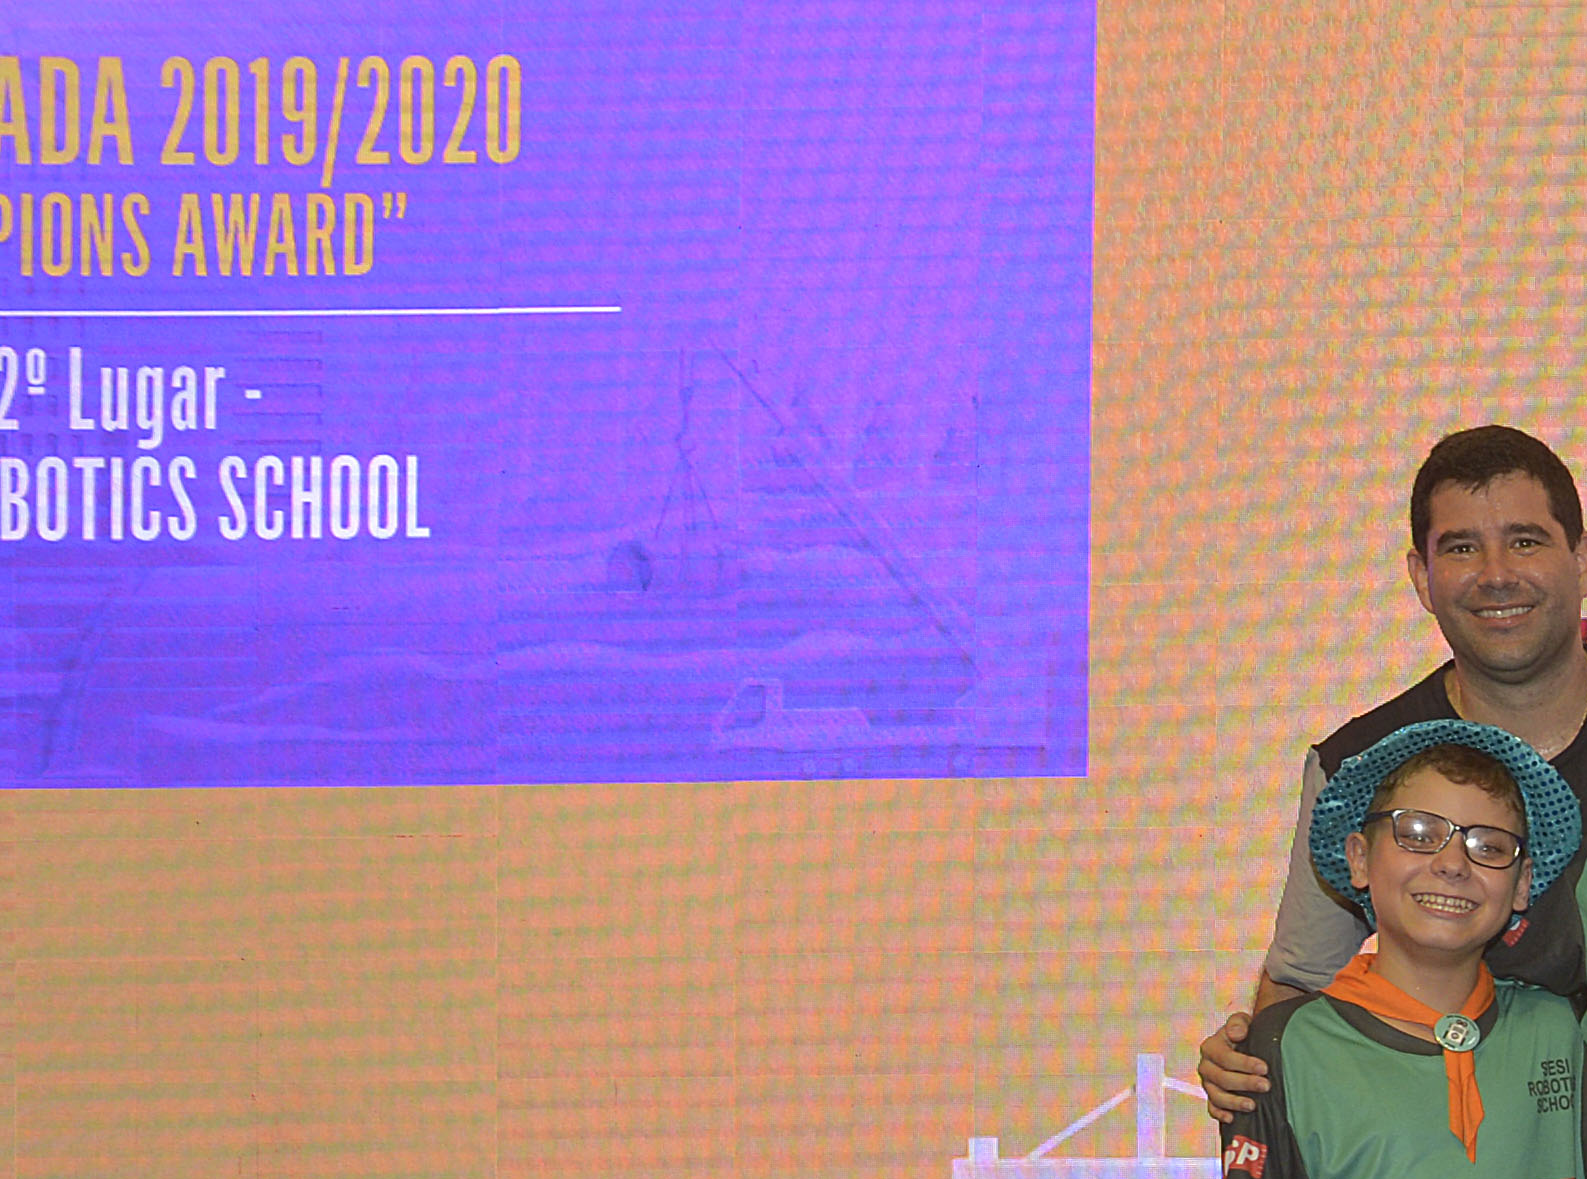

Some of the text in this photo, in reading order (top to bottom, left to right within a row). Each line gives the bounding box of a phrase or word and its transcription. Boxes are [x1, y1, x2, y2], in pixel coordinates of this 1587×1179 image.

[160, 54, 522, 187] 2019/2020
[69, 346, 225, 450] Lugar
[219, 454, 430, 540] SCHOOL
[1541, 1058, 1570, 1077] SESI
